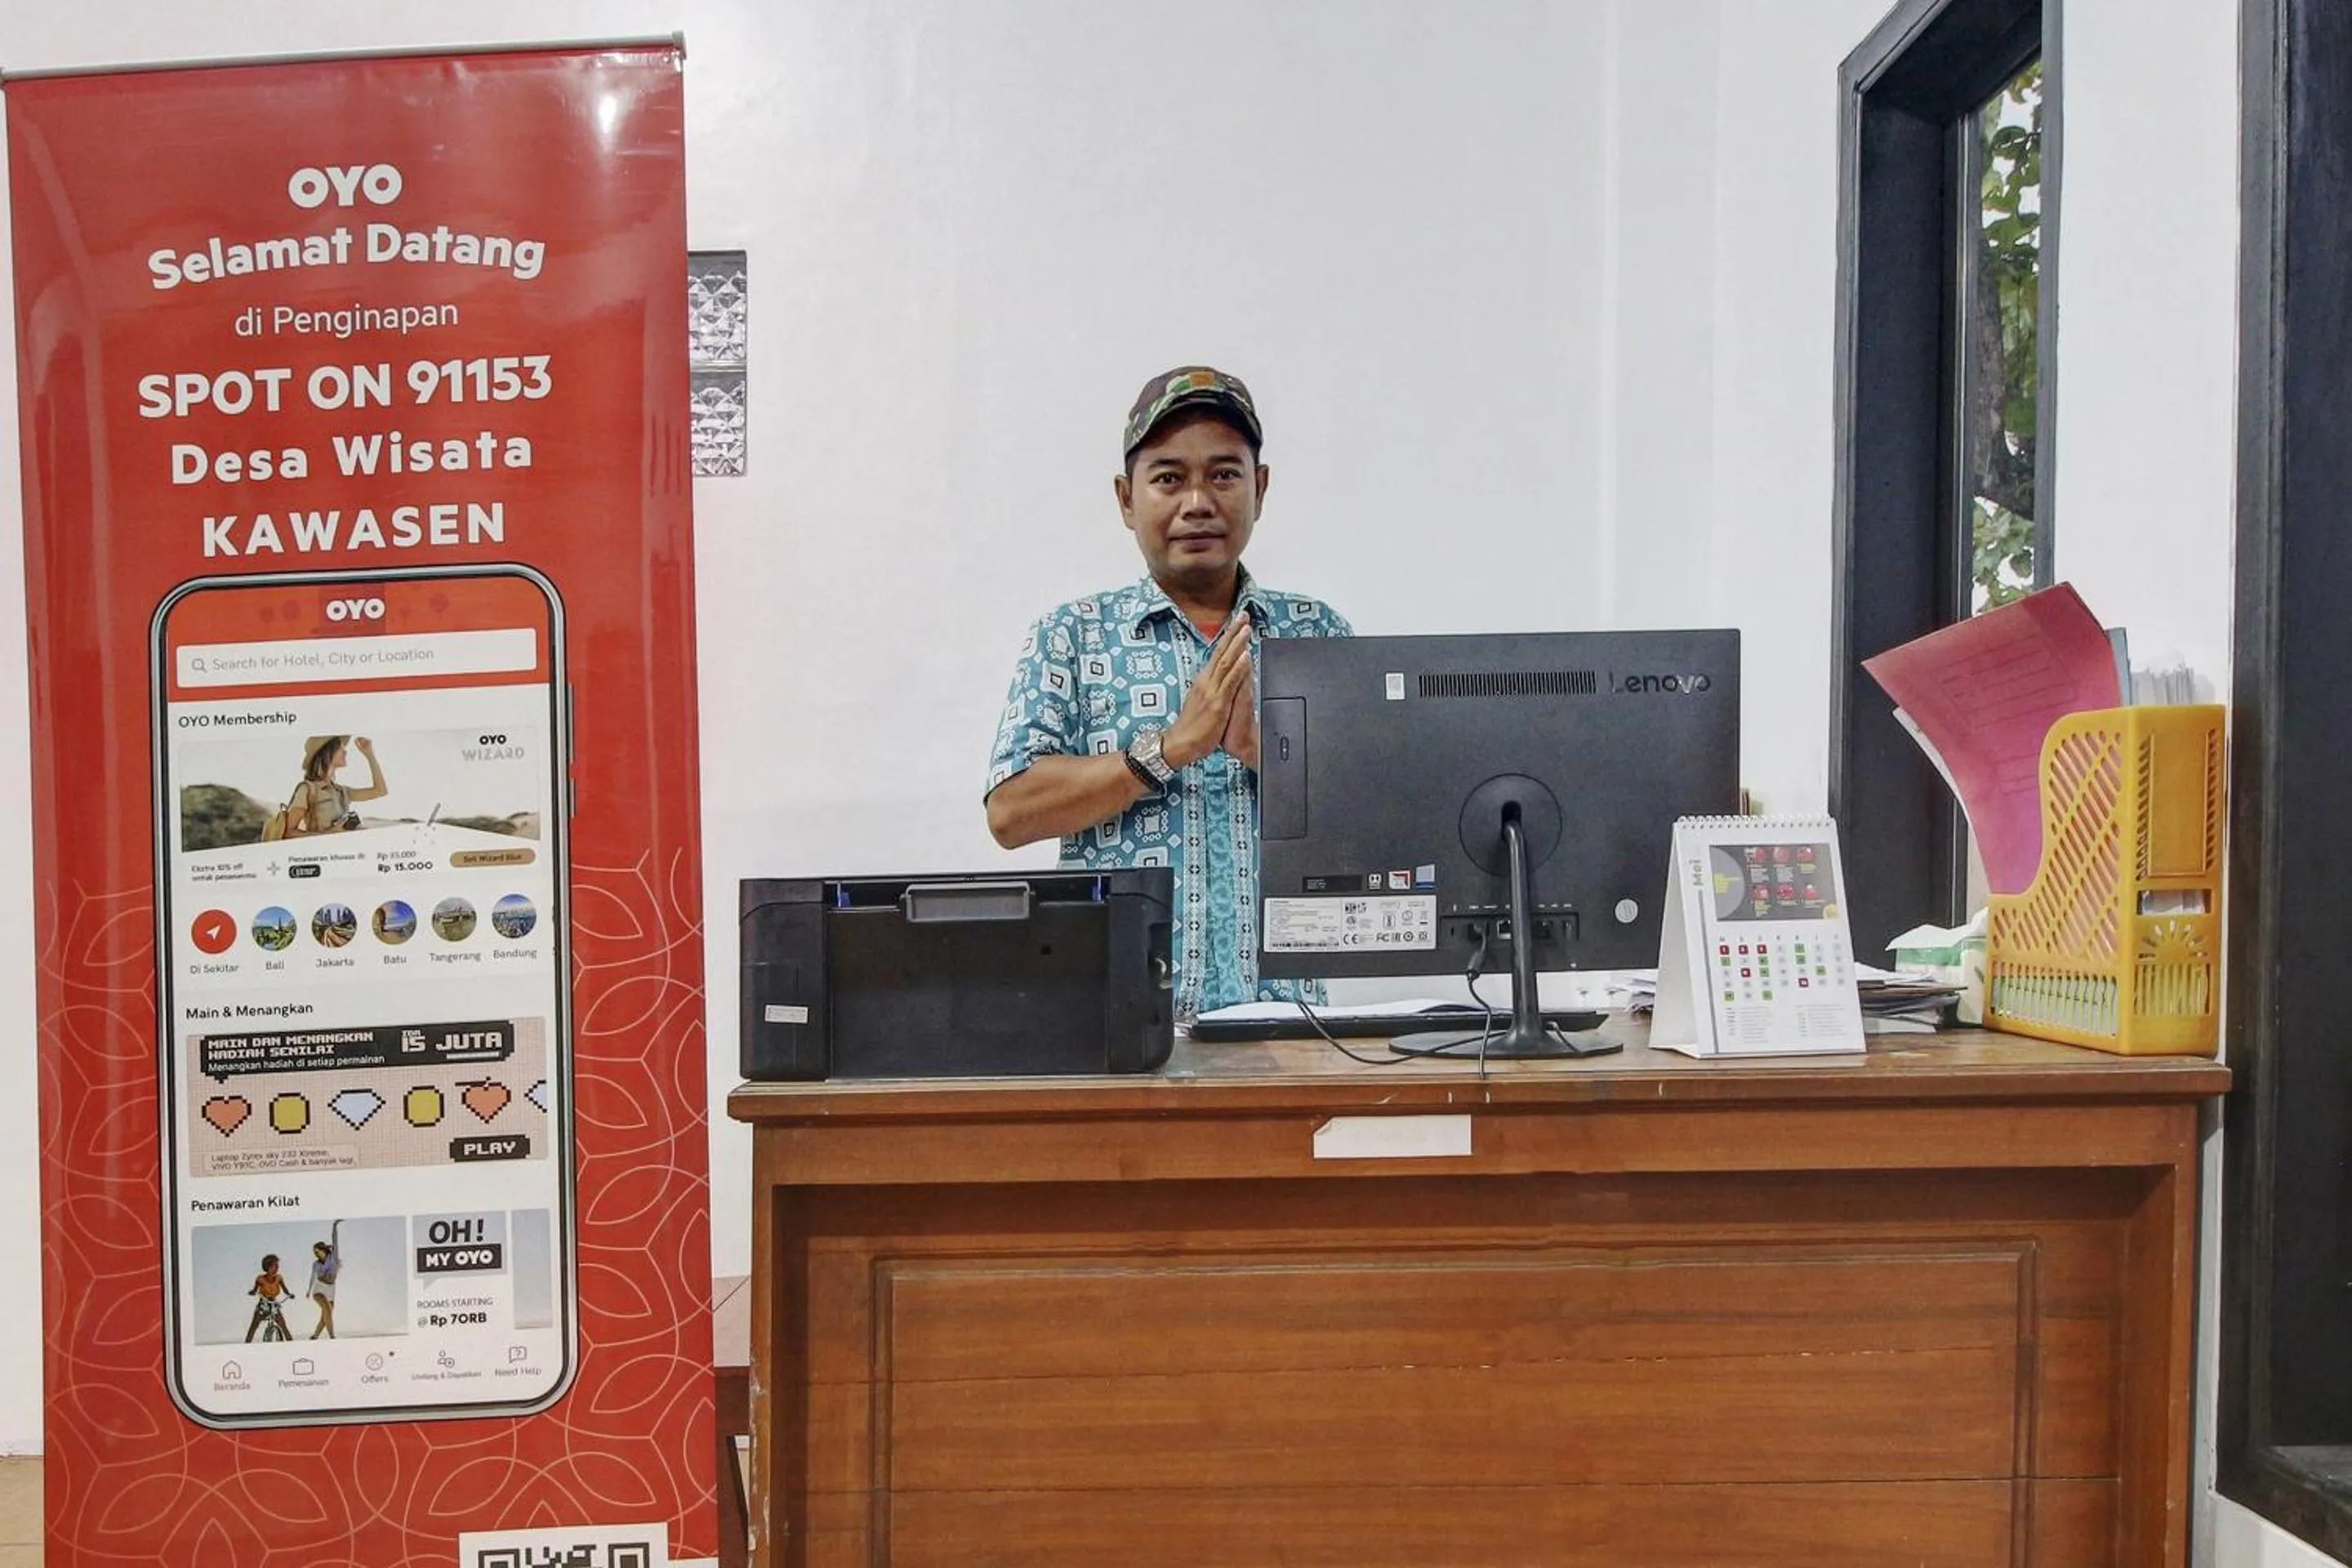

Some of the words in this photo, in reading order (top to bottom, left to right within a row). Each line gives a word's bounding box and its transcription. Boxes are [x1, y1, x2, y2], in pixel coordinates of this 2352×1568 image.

[288, 163, 403, 209] OYO
[148, 226, 352, 290] Selamat
[367, 223, 545, 280] Datang
[234, 309, 262, 336] di
[274, 303, 459, 338] Penginapan
[139, 368, 291, 419] SPOT
[307, 363, 391, 412] ON
[407, 354, 552, 405] 91153
[172, 443, 309, 485] Desa
[332, 431, 532, 477] Wisata
[203, 503, 506, 558] KAWASEN
[326, 598, 385, 621] OYO
[212, 657, 257, 671] Search
[261, 655, 279, 669] for
[283, 653, 325, 669] Hotel,
[328, 652, 355, 670] City
[359, 654, 373, 664] or
[377, 648, 434, 662] Location
[1608, 671, 1711, 694] Lenovo
[178, 715, 210, 728] OYO
[213, 711, 297, 728] Membership
[479, 734, 507, 746] OYO
[462, 747, 525, 762] WIZARD
[377, 863, 391, 874] Rp
[395, 862, 434, 871] 15.000
[383, 955, 407, 964] Batu
[429, 952, 482, 964] Tangerang
[493, 949, 537, 960] Bandung
[189, 965, 202, 975] Di
[203, 964, 239, 973] Sekitar
[265, 960, 285, 970] Bali
[315, 958, 354, 969] Jakarta
[185, 1006, 219, 1020] Main
[222, 1005, 233, 1018] &
[236, 1002, 314, 1020] Menangkan
[208, 1039, 247, 1049] MAIN
[252, 1036, 281, 1048] DAN
[286, 1032, 374, 1045] MENANGKAN
[401, 1036, 425, 1053] 15
[435, 1031, 502, 1051] JUTA
[208, 1049, 265, 1060] HADIAH
[270, 1045, 335, 1058] SENILAI
[208, 1062, 262, 1072] Menangkan
[263, 1059, 294, 1069] hadiah
[296, 1058, 305, 1067] di
[306, 1057, 335, 1067] setiap
[336, 1055, 385, 1066] permainan
[463, 1141, 517, 1157] PLAY
[190, 1198, 265, 1212] Penawaran
[268, 1195, 301, 1209] Kilat
[425, 1252, 451, 1267] MY
[455, 1249, 493, 1265] OYO
[416, 1299, 449, 1308] ROOMS
[452, 1297, 493, 1307] STARTING
[430, 1315, 448, 1327] Rp
[361, 1375, 389, 1384] Offers
[495, 1368, 518, 1376] Need
[521, 1367, 541, 1377] Help
